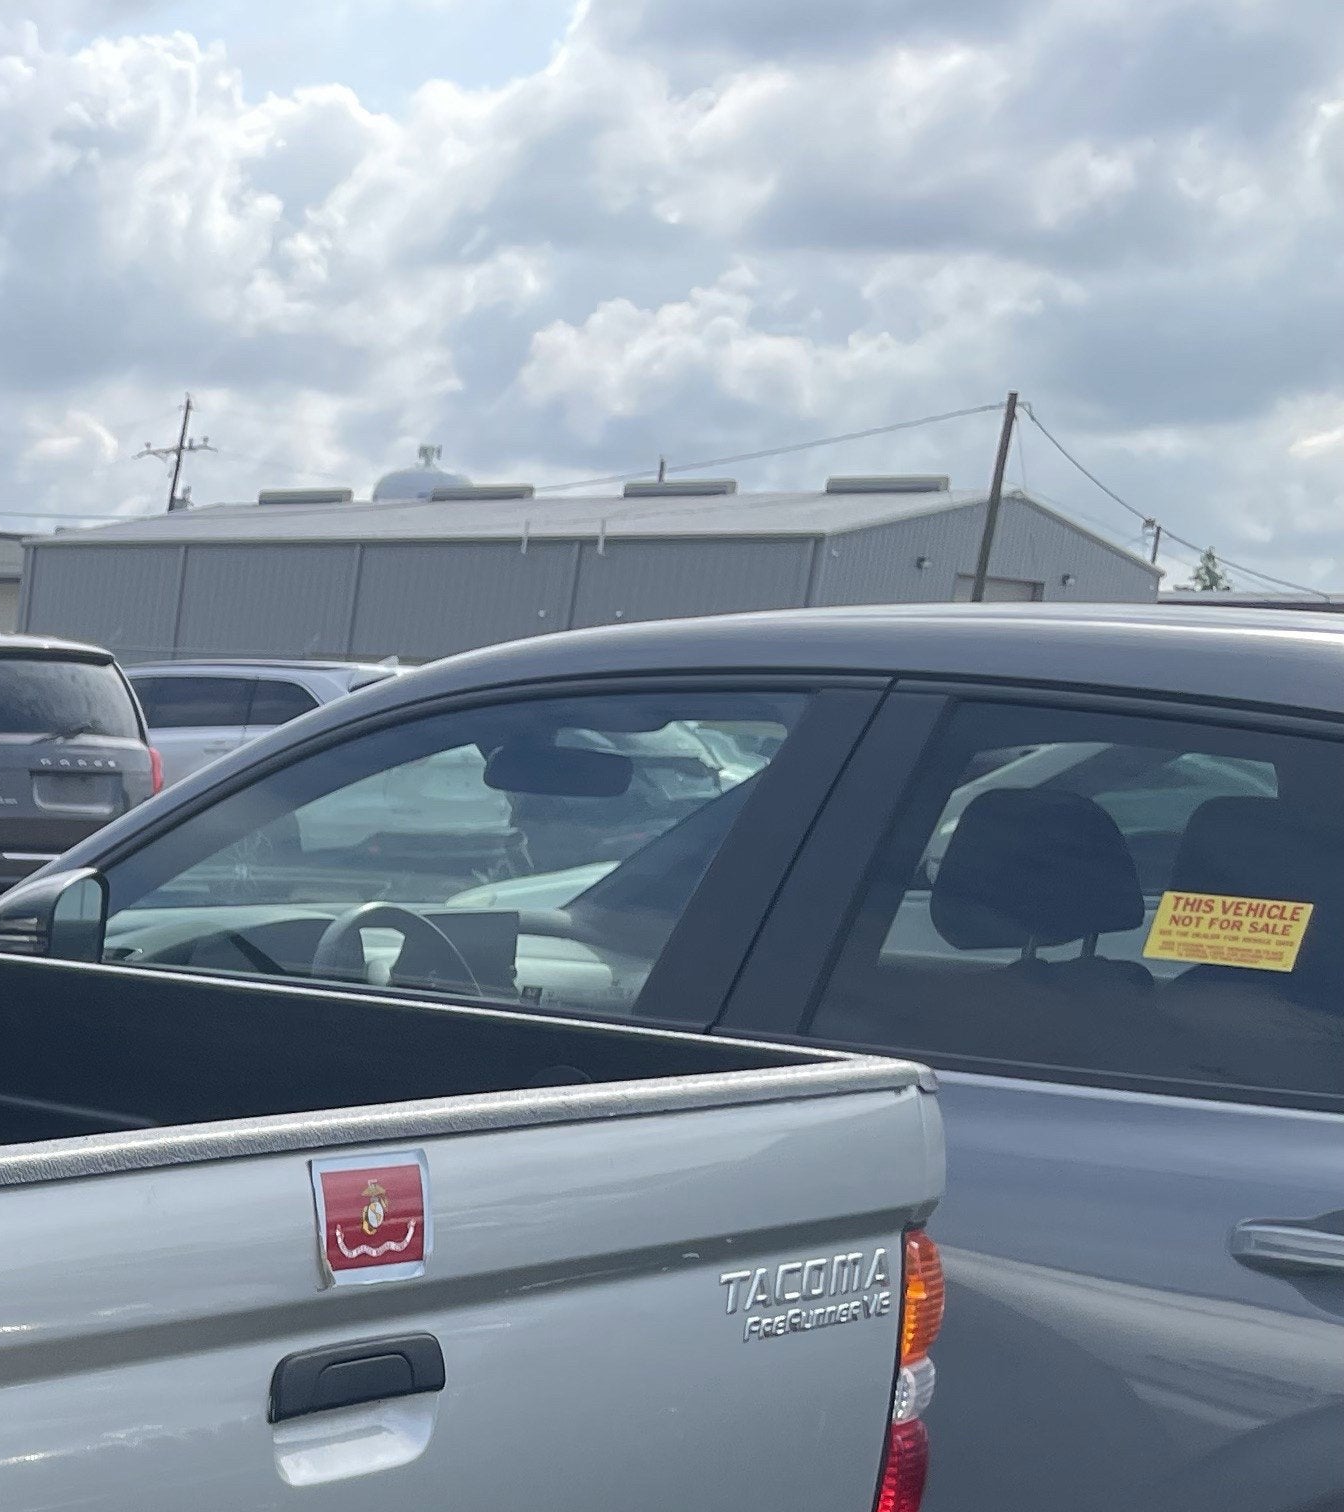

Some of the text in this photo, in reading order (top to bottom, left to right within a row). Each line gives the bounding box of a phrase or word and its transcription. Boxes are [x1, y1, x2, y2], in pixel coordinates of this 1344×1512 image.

[1171, 895, 1305, 923] THIS VEHICLE
[1168, 914, 1294, 937] NOT FOR SALE
[719, 1247, 891, 1315] TACOMA
